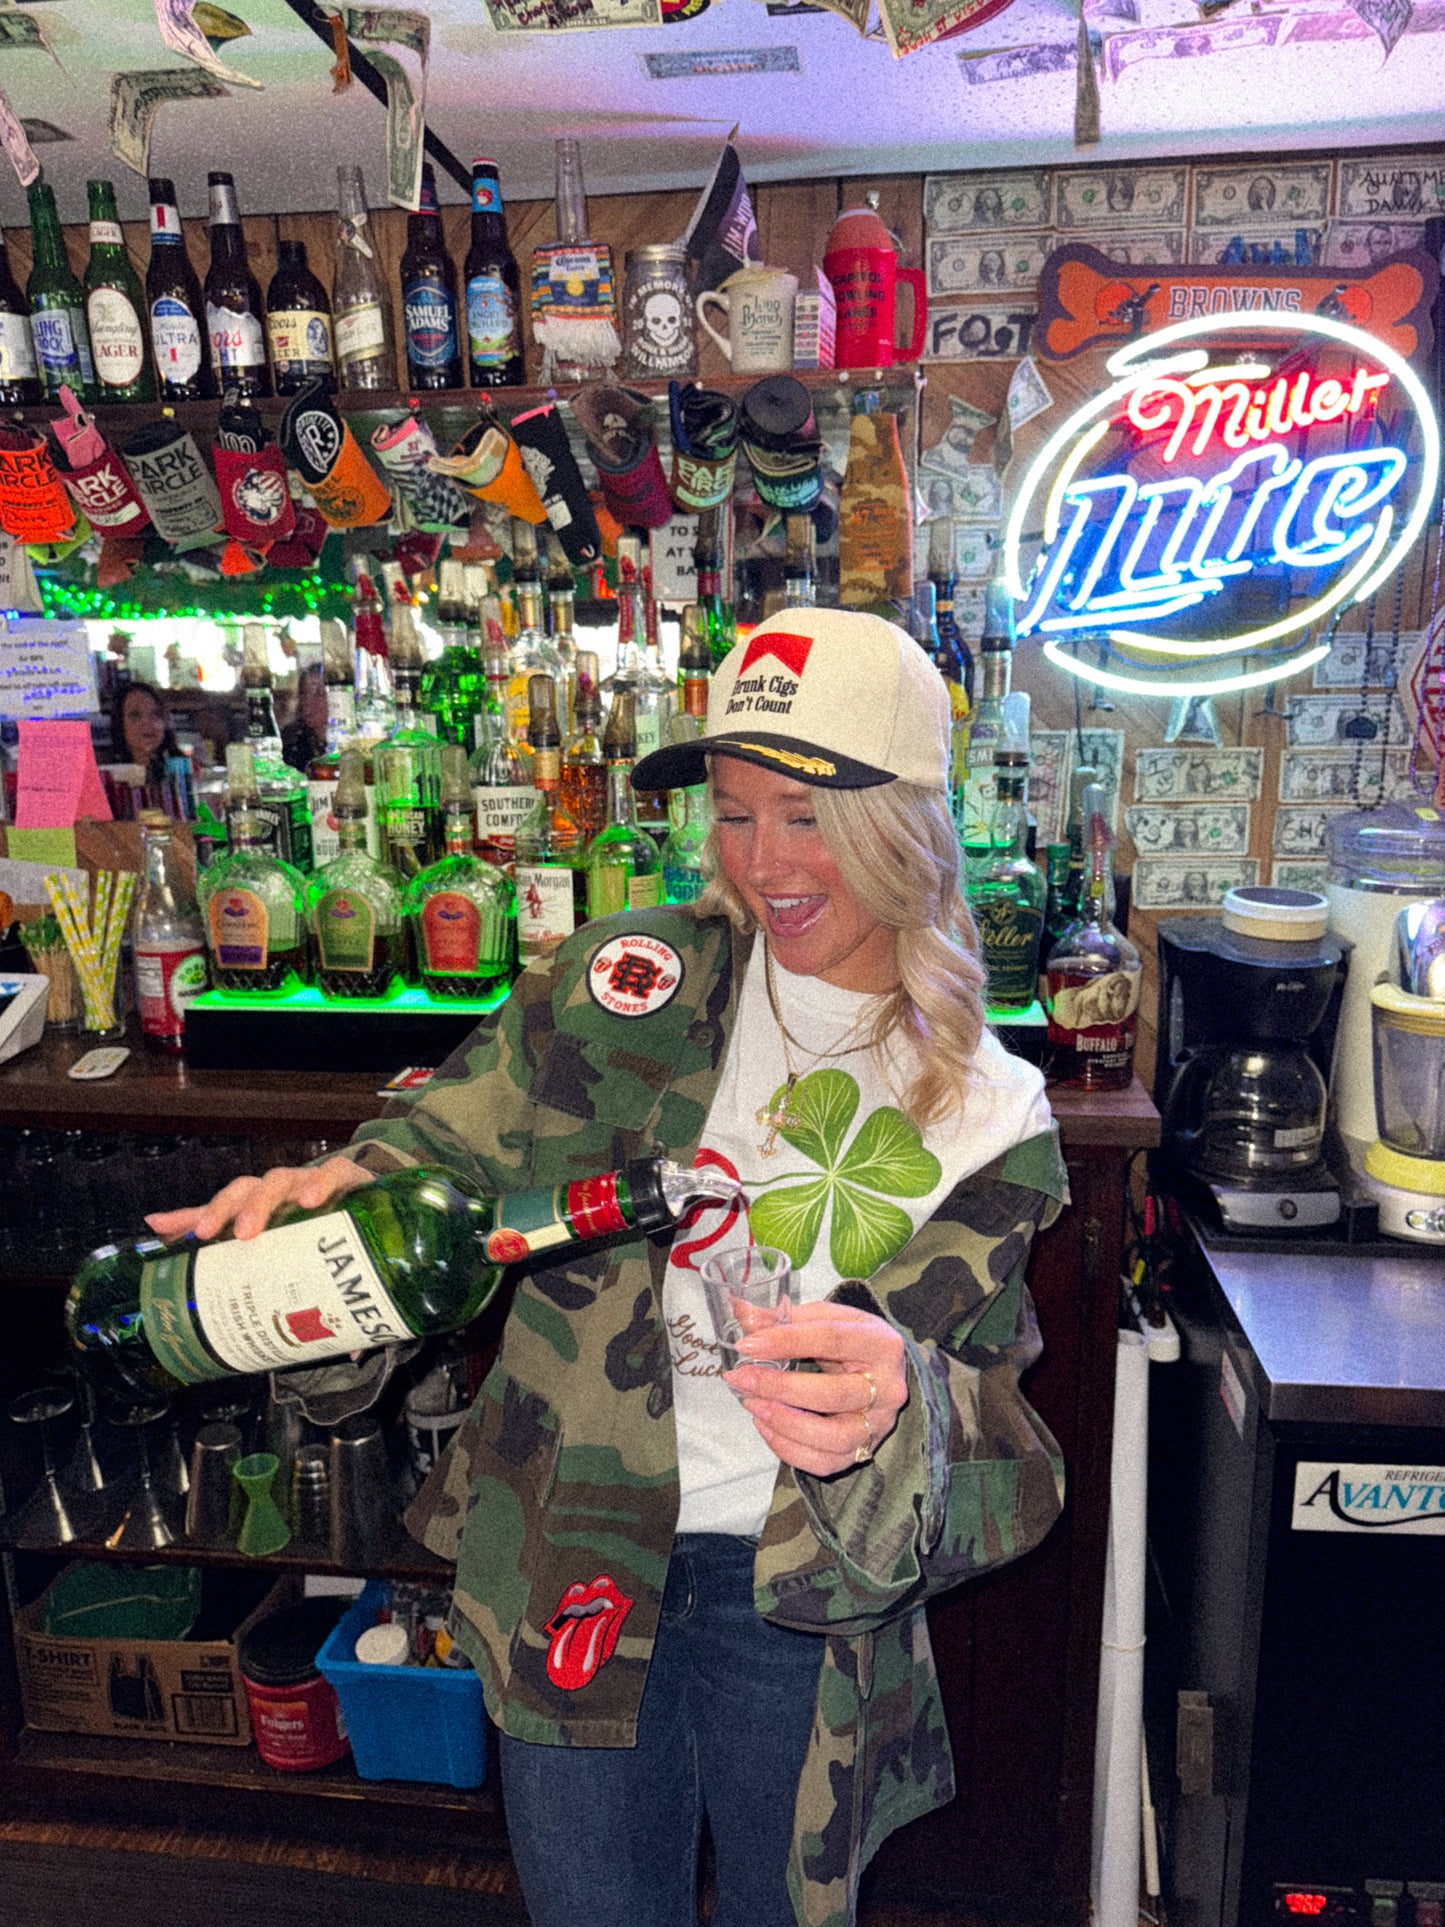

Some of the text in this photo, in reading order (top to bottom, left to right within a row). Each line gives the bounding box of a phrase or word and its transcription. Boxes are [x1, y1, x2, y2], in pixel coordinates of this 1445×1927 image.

[405, 304, 452, 320] SAMUEL
[1168, 286, 1302, 320] BROWNS
[409, 318, 449, 333] ADAMS
[1127, 366, 1392, 463] Miller
[126, 441, 196, 479] PARK
[670, 526, 688, 536] TO
[731, 674, 799, 697] Drunk Cigs
[725, 696, 793, 716] Don't Count
[386, 820, 426, 835] HONEY
[534, 873, 571, 891] Morgan
[620, 938, 674, 962] ROLLING
[600, 991, 649, 1013] STONES
[1075, 1033, 1119, 1053] BUFFALO
[229, 1298, 247, 1331] IRISH
[24, 1646, 92, 1667] T-SHIRT
